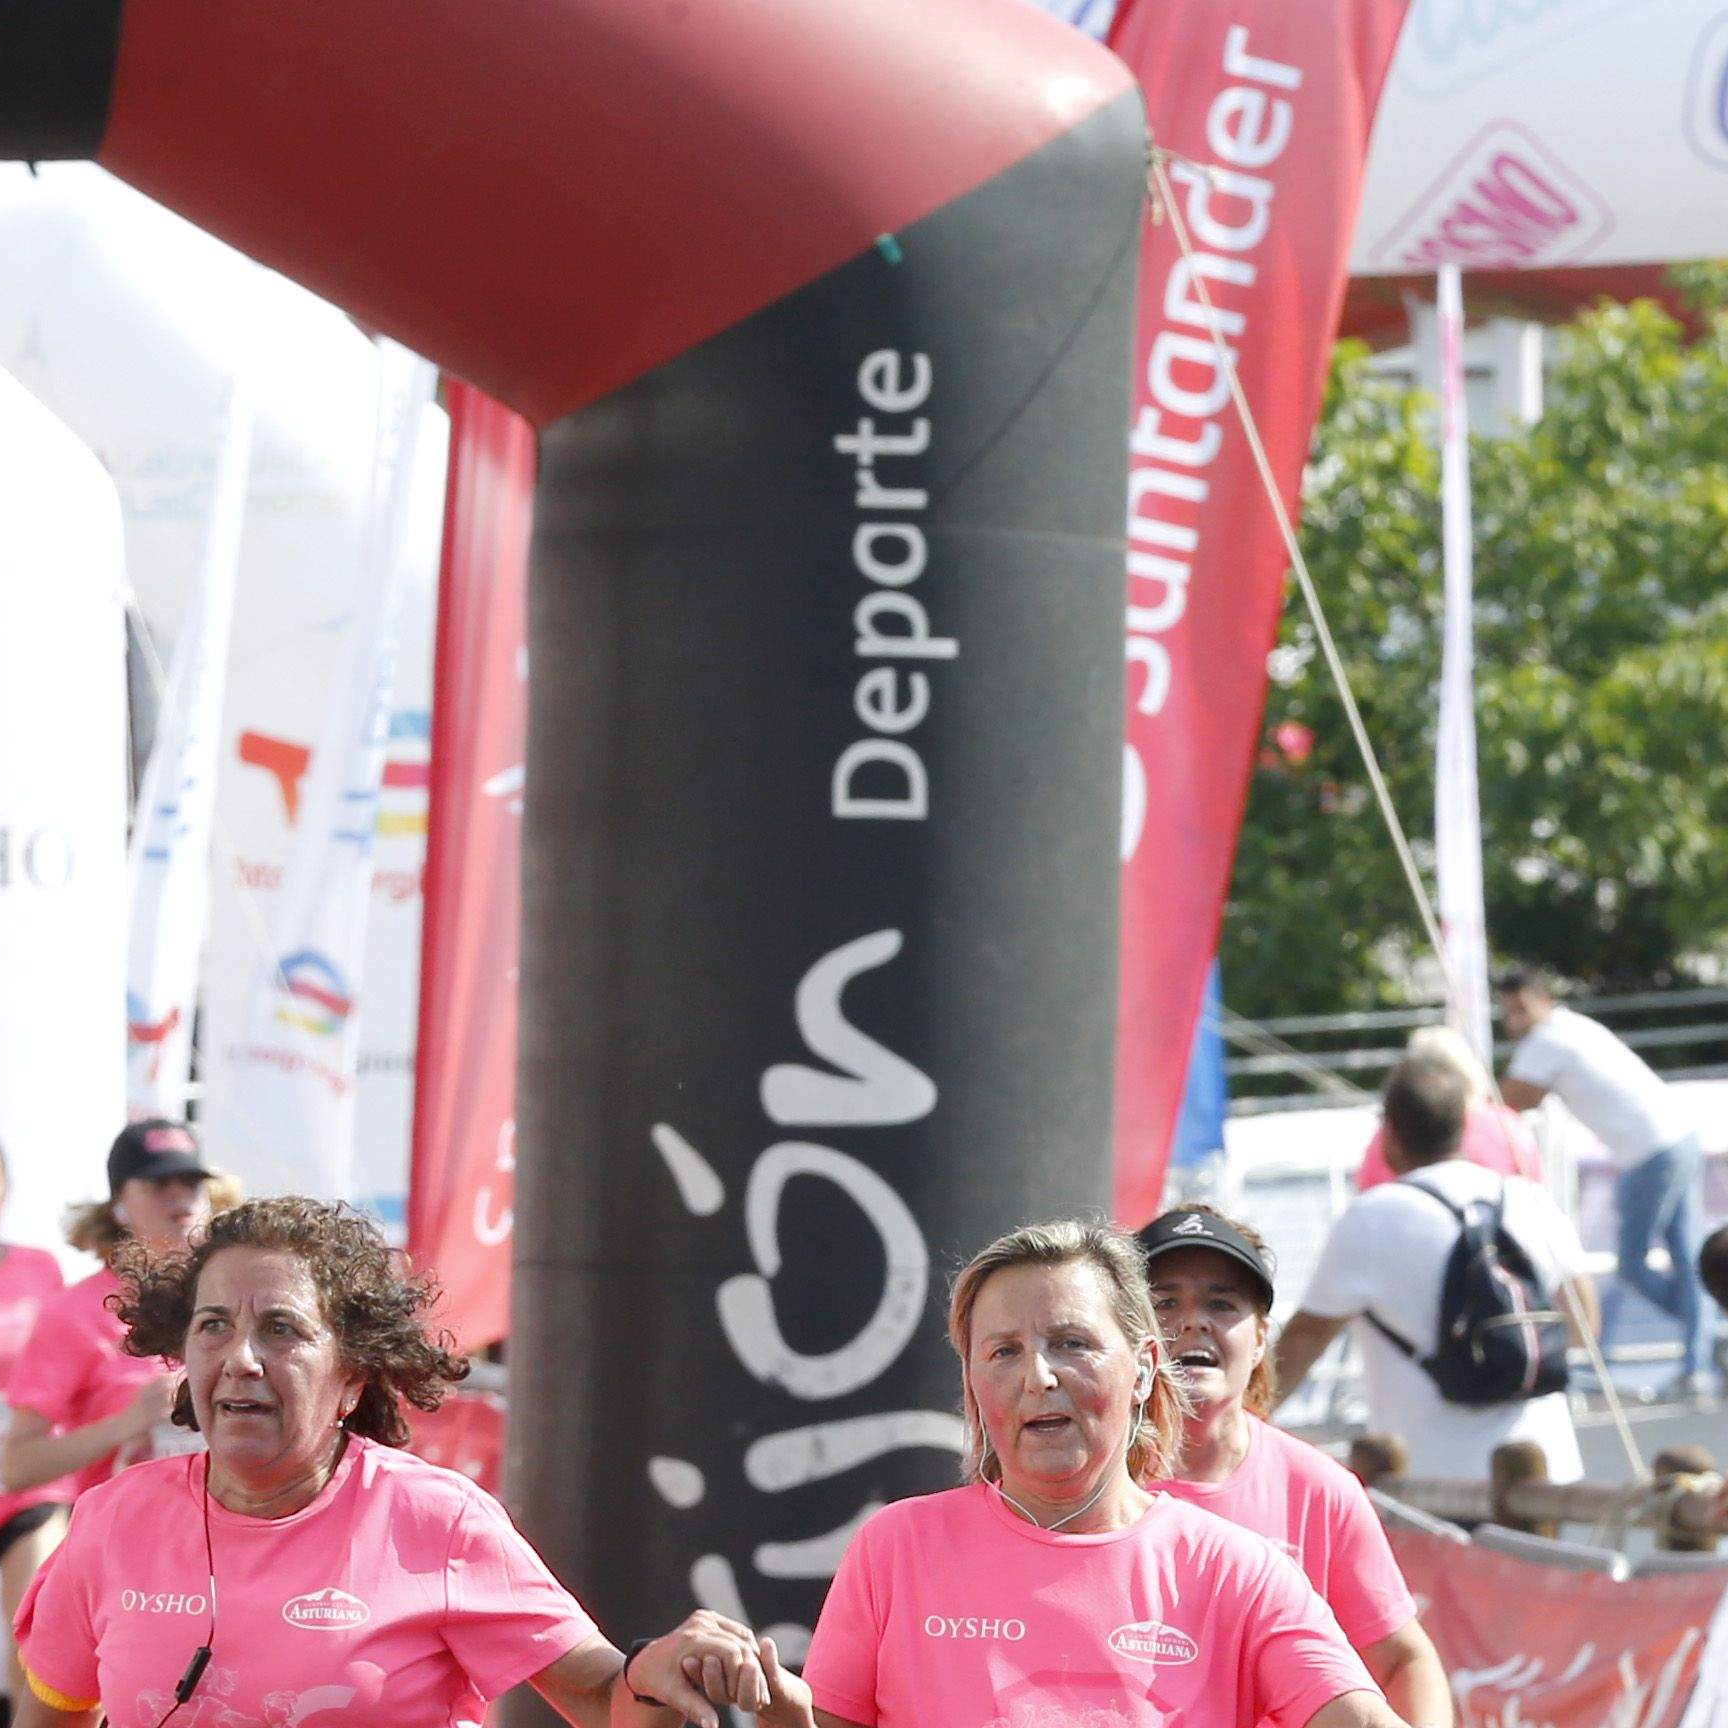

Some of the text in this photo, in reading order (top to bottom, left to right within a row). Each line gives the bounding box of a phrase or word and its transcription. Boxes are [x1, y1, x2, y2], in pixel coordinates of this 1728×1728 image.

[831, 346, 960, 821] Deporte
[121, 1588, 207, 1616] OYSHO
[289, 1603, 363, 1621] ASTURIANA
[925, 1615, 1026, 1641] OYSHO
[1116, 1633, 1192, 1659] ASTURIANA
